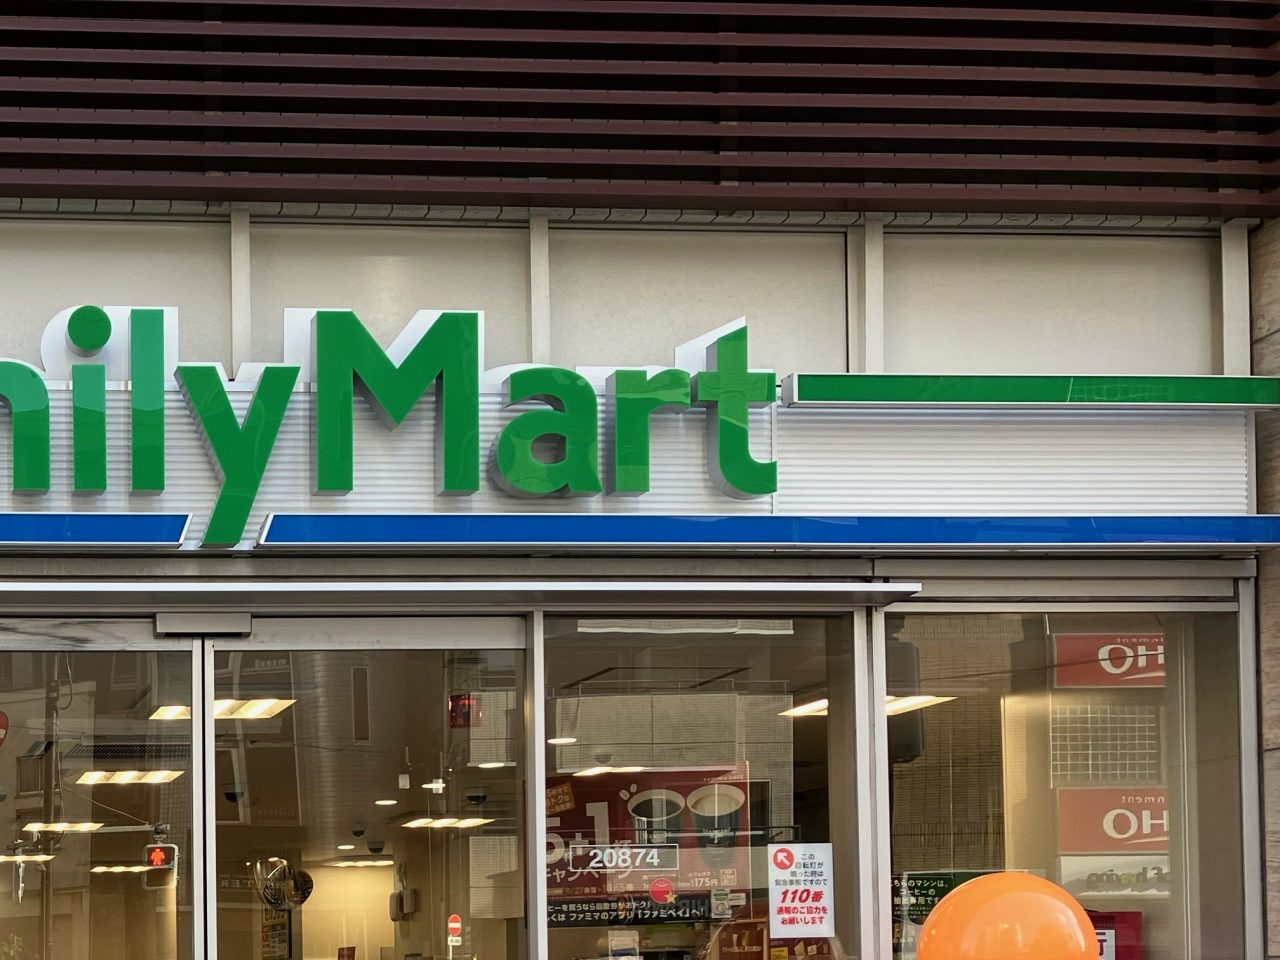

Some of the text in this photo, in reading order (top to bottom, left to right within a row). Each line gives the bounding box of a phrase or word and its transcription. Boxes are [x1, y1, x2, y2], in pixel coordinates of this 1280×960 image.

[589, 849, 660, 867] 20874
[781, 889, 824, 903] 110番
[781, 917, 825, 925] お願いします
